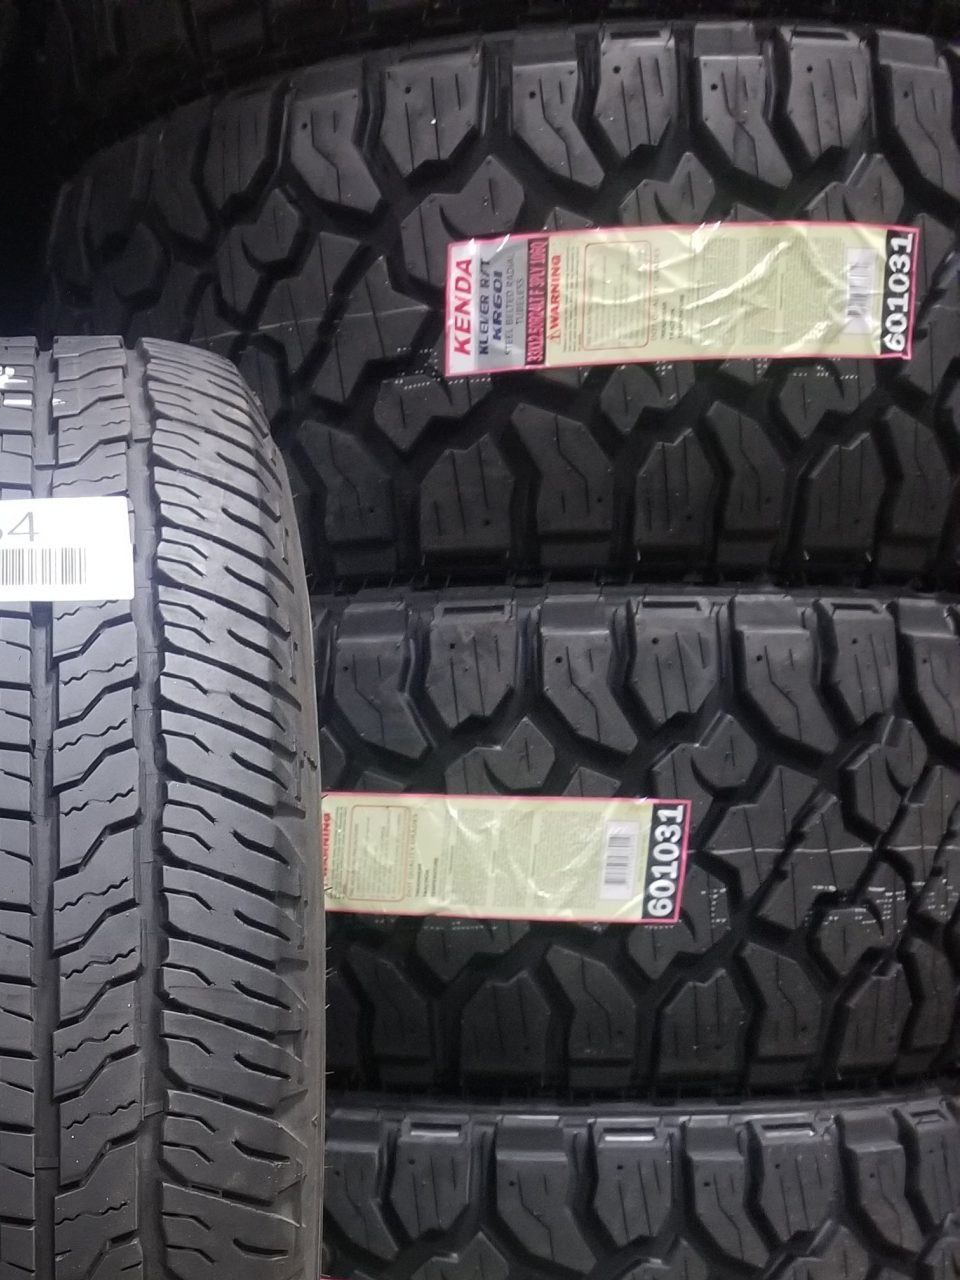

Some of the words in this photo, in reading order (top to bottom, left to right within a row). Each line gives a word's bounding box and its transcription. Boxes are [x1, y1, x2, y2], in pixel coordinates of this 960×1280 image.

[453, 258, 473, 355] KENDA
[480, 258, 489, 288] R/T
[493, 271, 502, 341] KR601
[505, 290, 513, 325] BELTED
[516, 278, 524, 324] TUBELESS
[550, 254, 561, 330] WARNING
[883, 233, 913, 352] 601031
[480, 295, 489, 355] KLEVER
[647, 805, 684, 917] 601031
